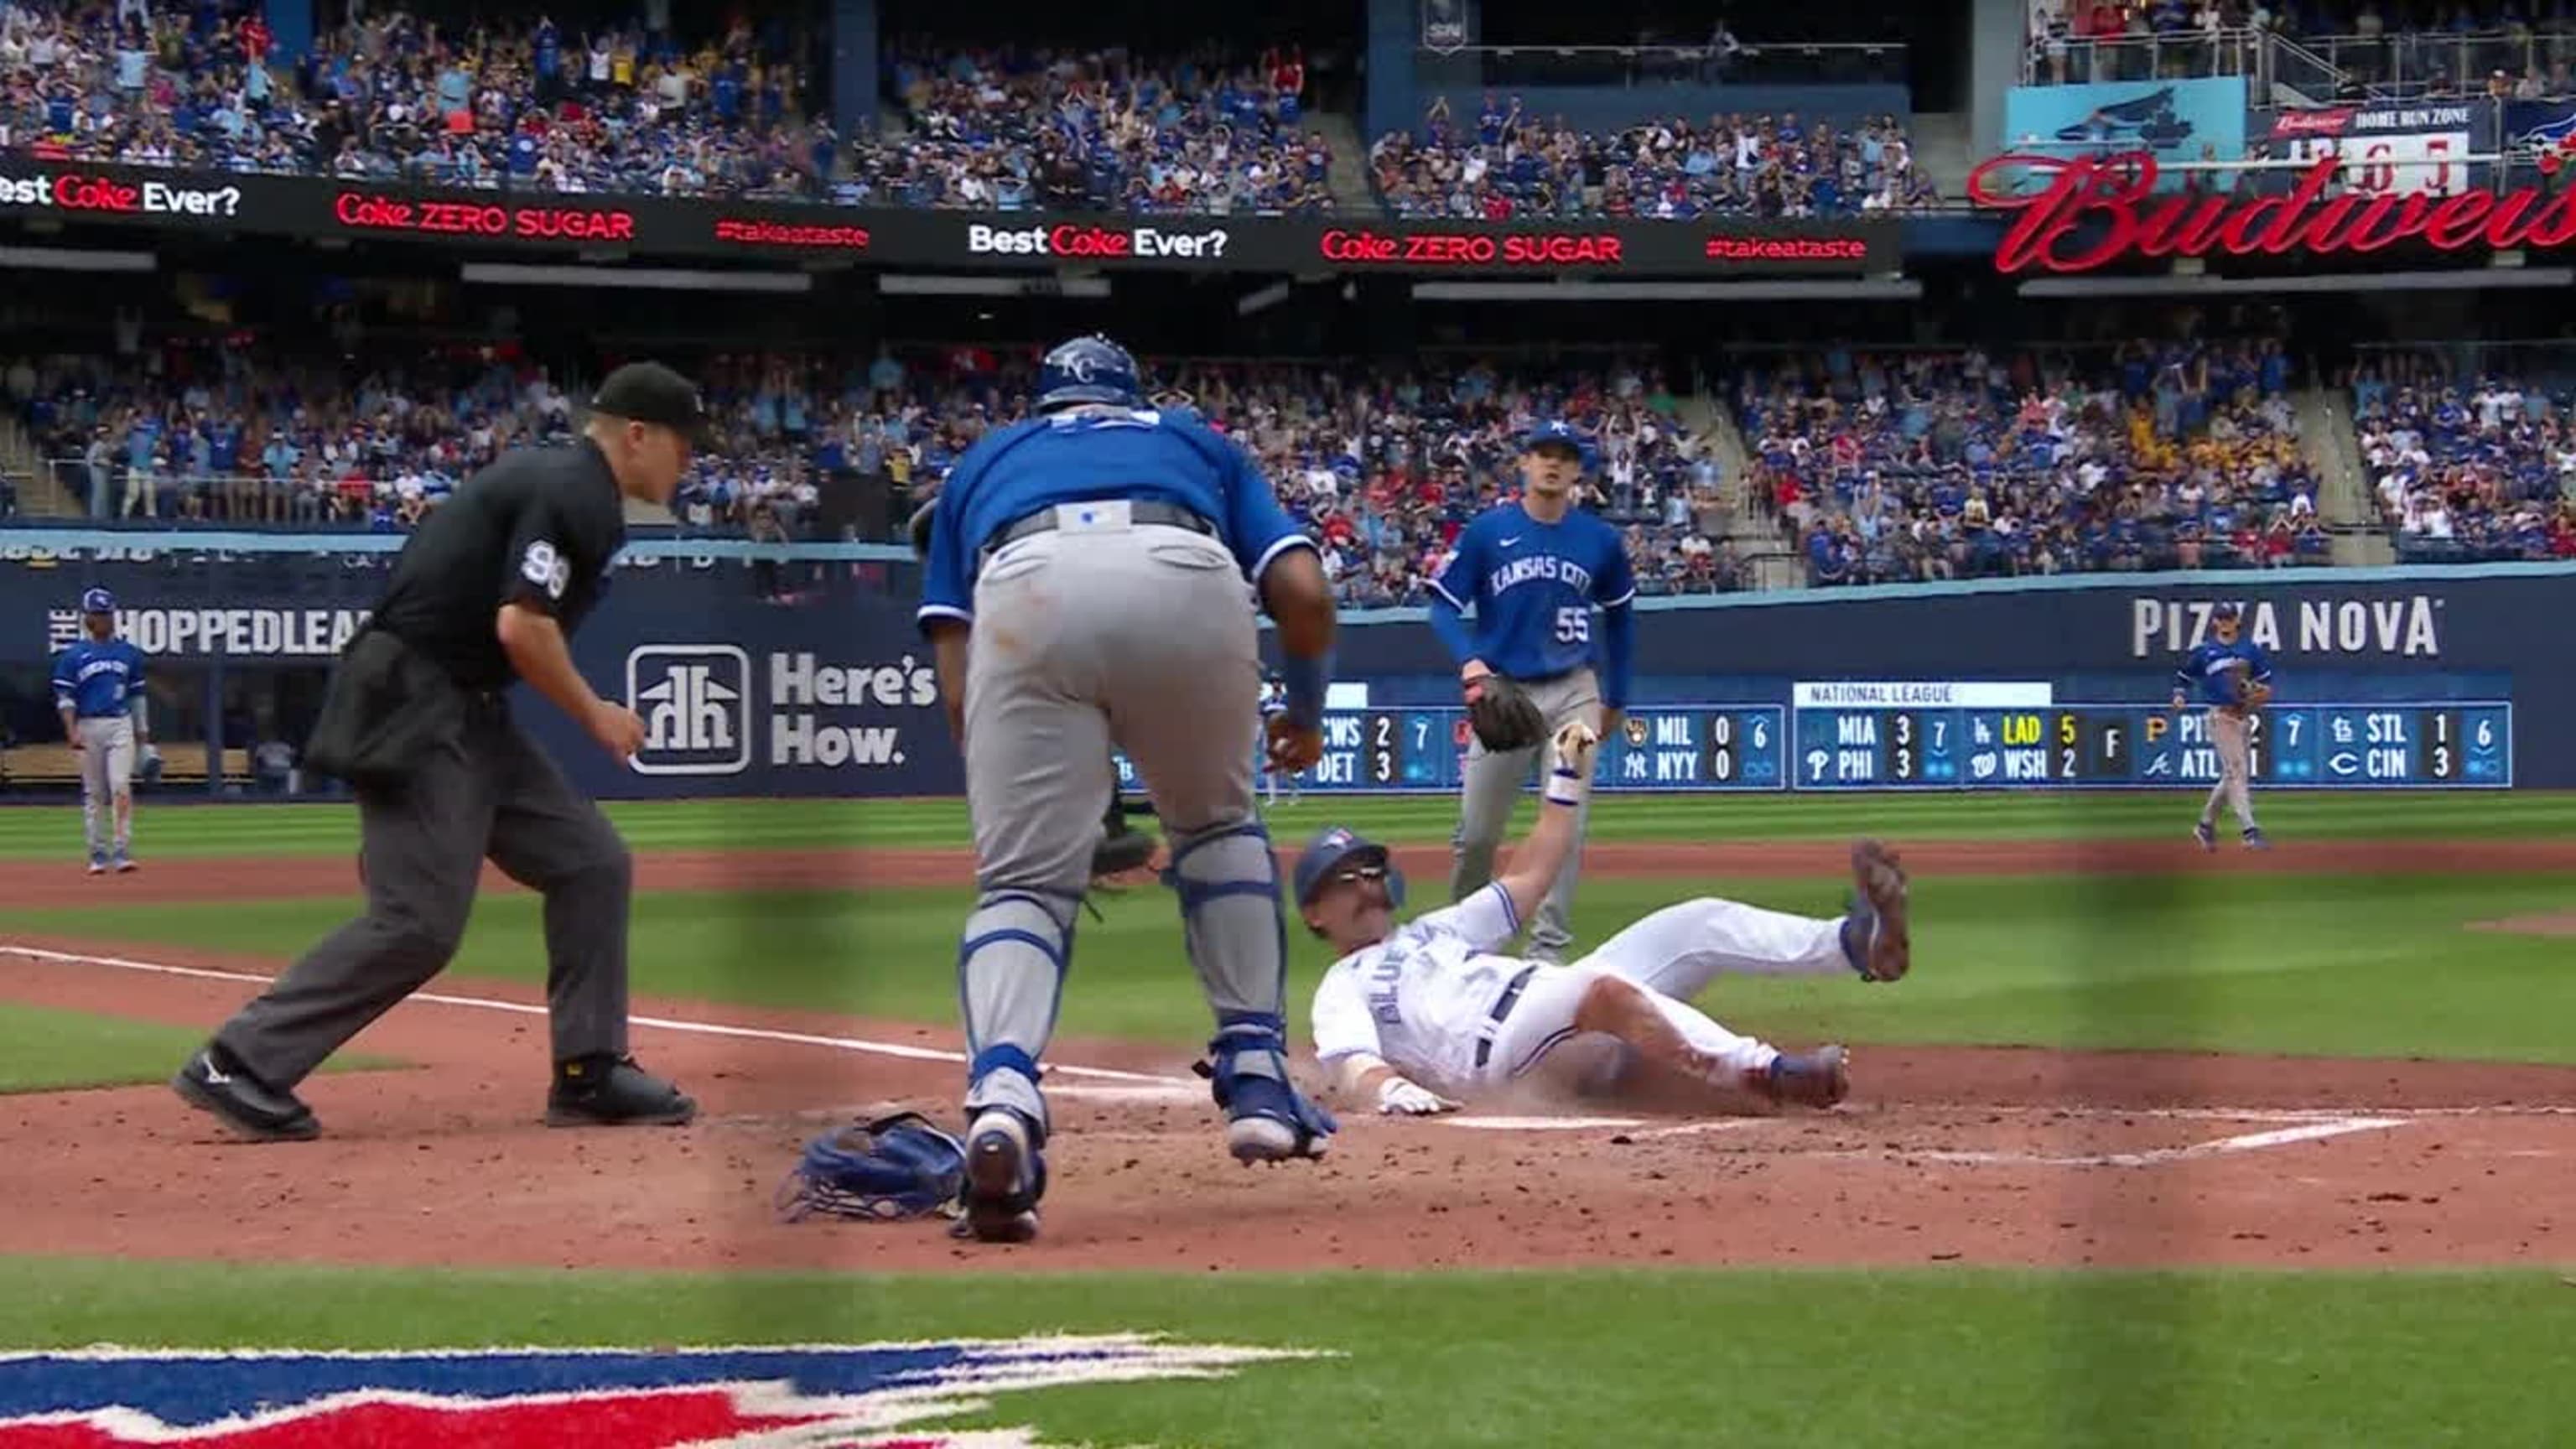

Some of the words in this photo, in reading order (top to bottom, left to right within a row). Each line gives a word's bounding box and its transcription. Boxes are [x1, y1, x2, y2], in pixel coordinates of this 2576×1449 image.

[2355, 111, 2397, 128] HOME
[2400, 109, 2430, 127] RUN
[2433, 106, 2470, 125] ZONE
[54, 174, 140, 211] Coke
[143, 181, 241, 216] Ever?
[335, 192, 417, 228] Coke
[419, 202, 507, 233] ZERO
[515, 209, 634, 239] SUGAR
[716, 220, 870, 247] #takeataste
[969, 224, 1047, 252] Best
[1050, 224, 1130, 256] Coke
[1134, 228, 1228, 257] Ever?
[1322, 230, 1401, 260] Coke
[1404, 236, 1495, 261] ZERO
[1504, 236, 1622, 262] SUGAR
[1706, 237, 1867, 259] #takeataste
[1490, 556, 1556, 596] KANSAS
[1561, 558, 1591, 596] CITY
[49, 609, 78, 653] THE
[80, 610, 373, 655] HOPPEDLEA
[1555, 606, 1590, 642] 55
[2134, 598, 2283, 657] PIZA
[2300, 595, 2439, 656] NOVA
[769, 652, 937, 706] Here's
[1810, 685, 1887, 703] NATIONAL
[1892, 684, 1953, 703] LEAGUE
[771, 713, 906, 766] How.
[1376, 717, 1391, 746] 2
[1415, 723, 1427, 749] 7
[1656, 715, 1691, 745] MIL
[1715, 715, 1730, 745] 0
[1754, 723, 1766, 749] 6
[1837, 715, 1876, 745] MIA
[1896, 715, 1910, 745] 3
[1934, 722, 1946, 747] 7
[2003, 715, 2042, 745] LAD
[2060, 715, 2075, 745] 5
[2106, 730, 2120, 758] F
[2287, 719, 2301, 746] 7
[2366, 713, 2407, 743] STL
[2435, 714, 2446, 743] 1
[2478, 719, 2491, 746] 6
[1316, 751, 1356, 782] DET
[1376, 750, 1391, 782] 3
[1657, 751, 1698, 781] NYY
[1715, 749, 1730, 780] 0
[1837, 749, 1873, 780] PHI
[1896, 748, 1910, 778] 3
[2003, 749, 2047, 779] WSH
[2061, 748, 2076, 777] 2
[2181, 749, 2220, 778] ATL
[2367, 748, 2407, 777] CIN
[2433, 746, 2449, 777] 3
